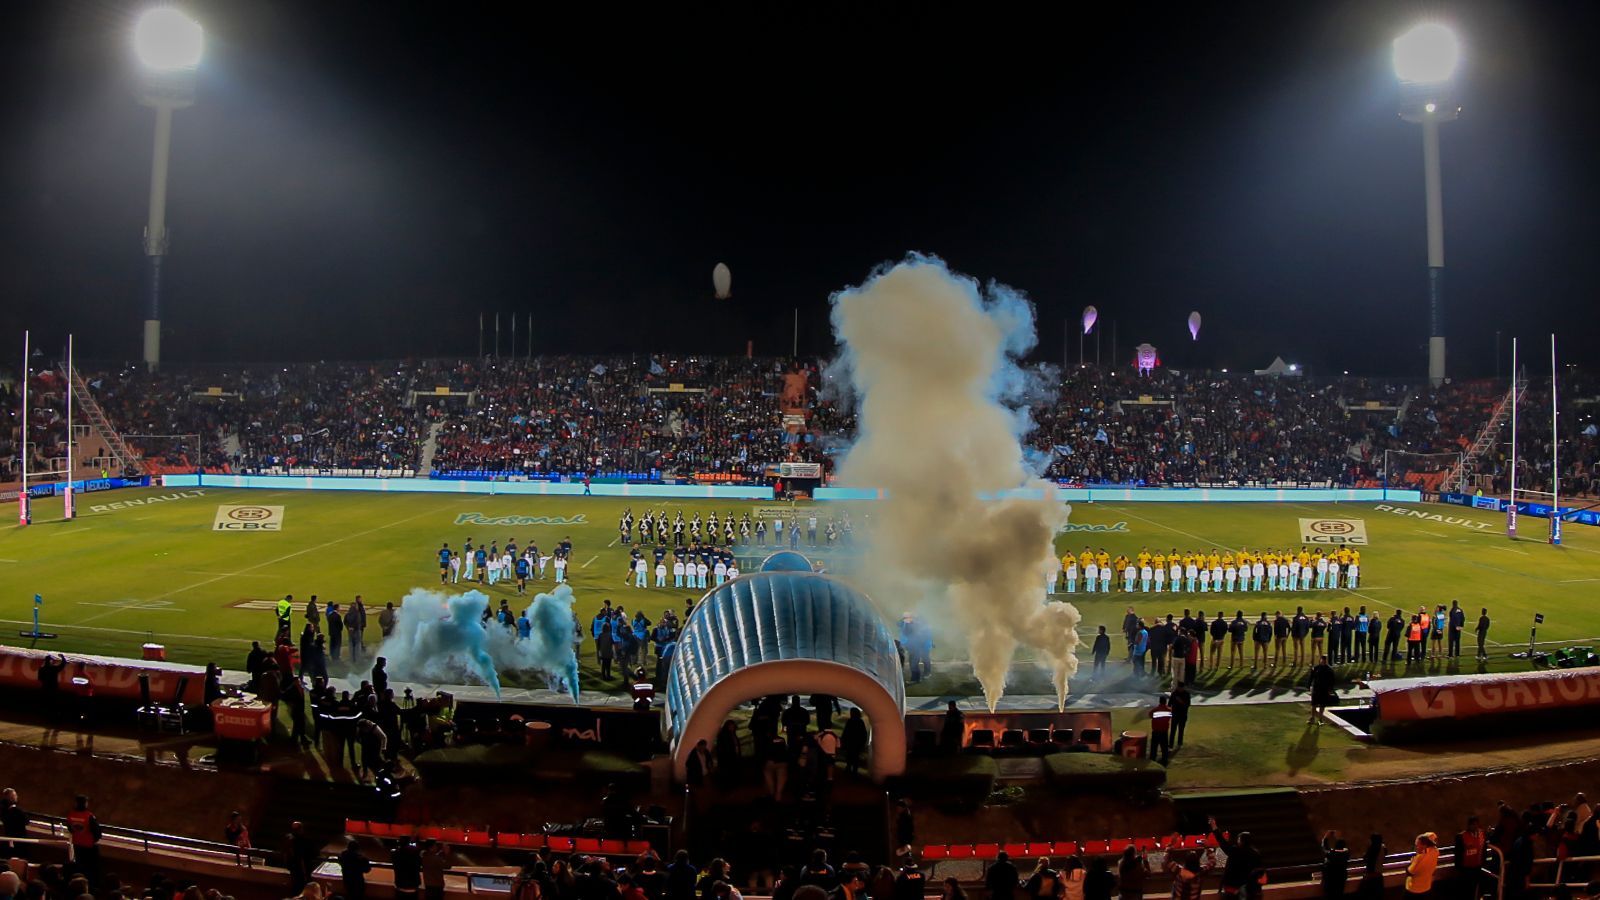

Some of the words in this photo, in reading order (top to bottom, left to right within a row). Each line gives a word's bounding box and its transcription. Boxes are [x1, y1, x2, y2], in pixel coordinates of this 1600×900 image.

[90, 489, 207, 514] RENAULT
[453, 511, 590, 526] Personal
[1374, 504, 1493, 530] RENAULT
[218, 521, 278, 530] ICBC
[1305, 535, 1364, 544] ICBC
